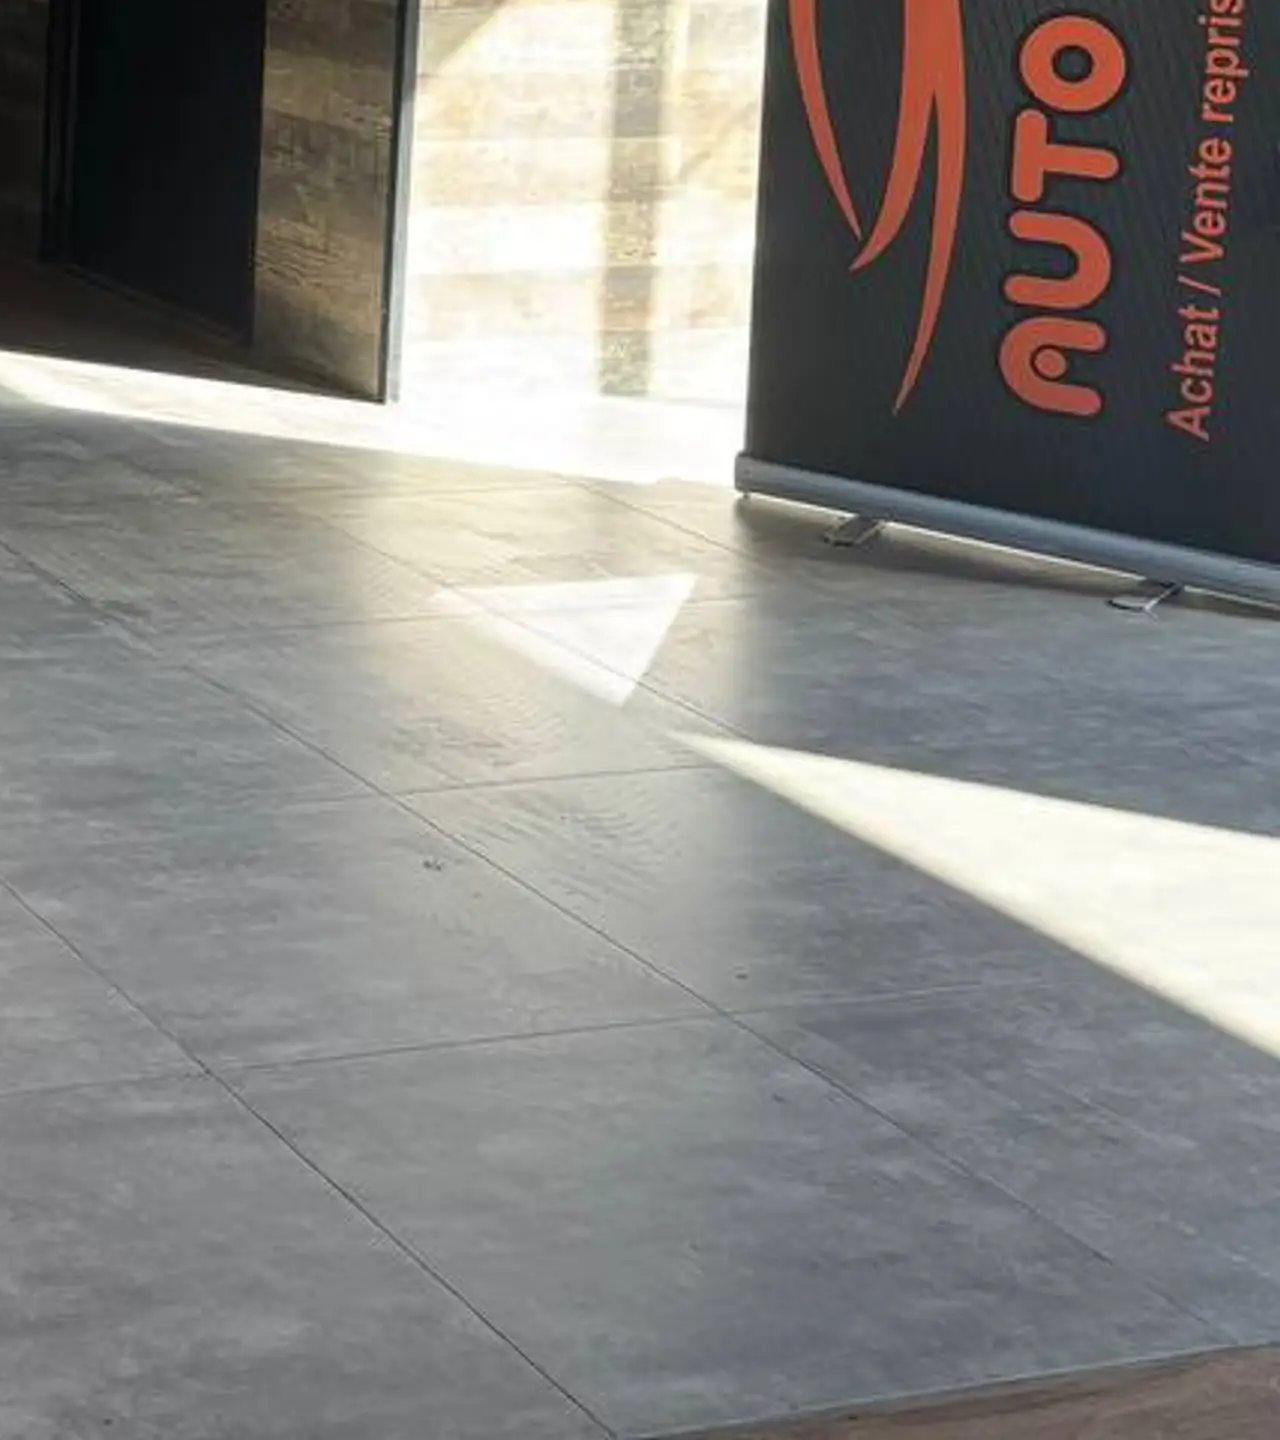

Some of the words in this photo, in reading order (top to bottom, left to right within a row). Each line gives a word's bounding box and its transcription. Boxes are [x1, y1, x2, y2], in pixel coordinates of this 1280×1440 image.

[1000, 15, 1125, 414] AUTO
[1179, 137, 1233, 267] Vente
[1166, 308, 1220, 442] Achat
